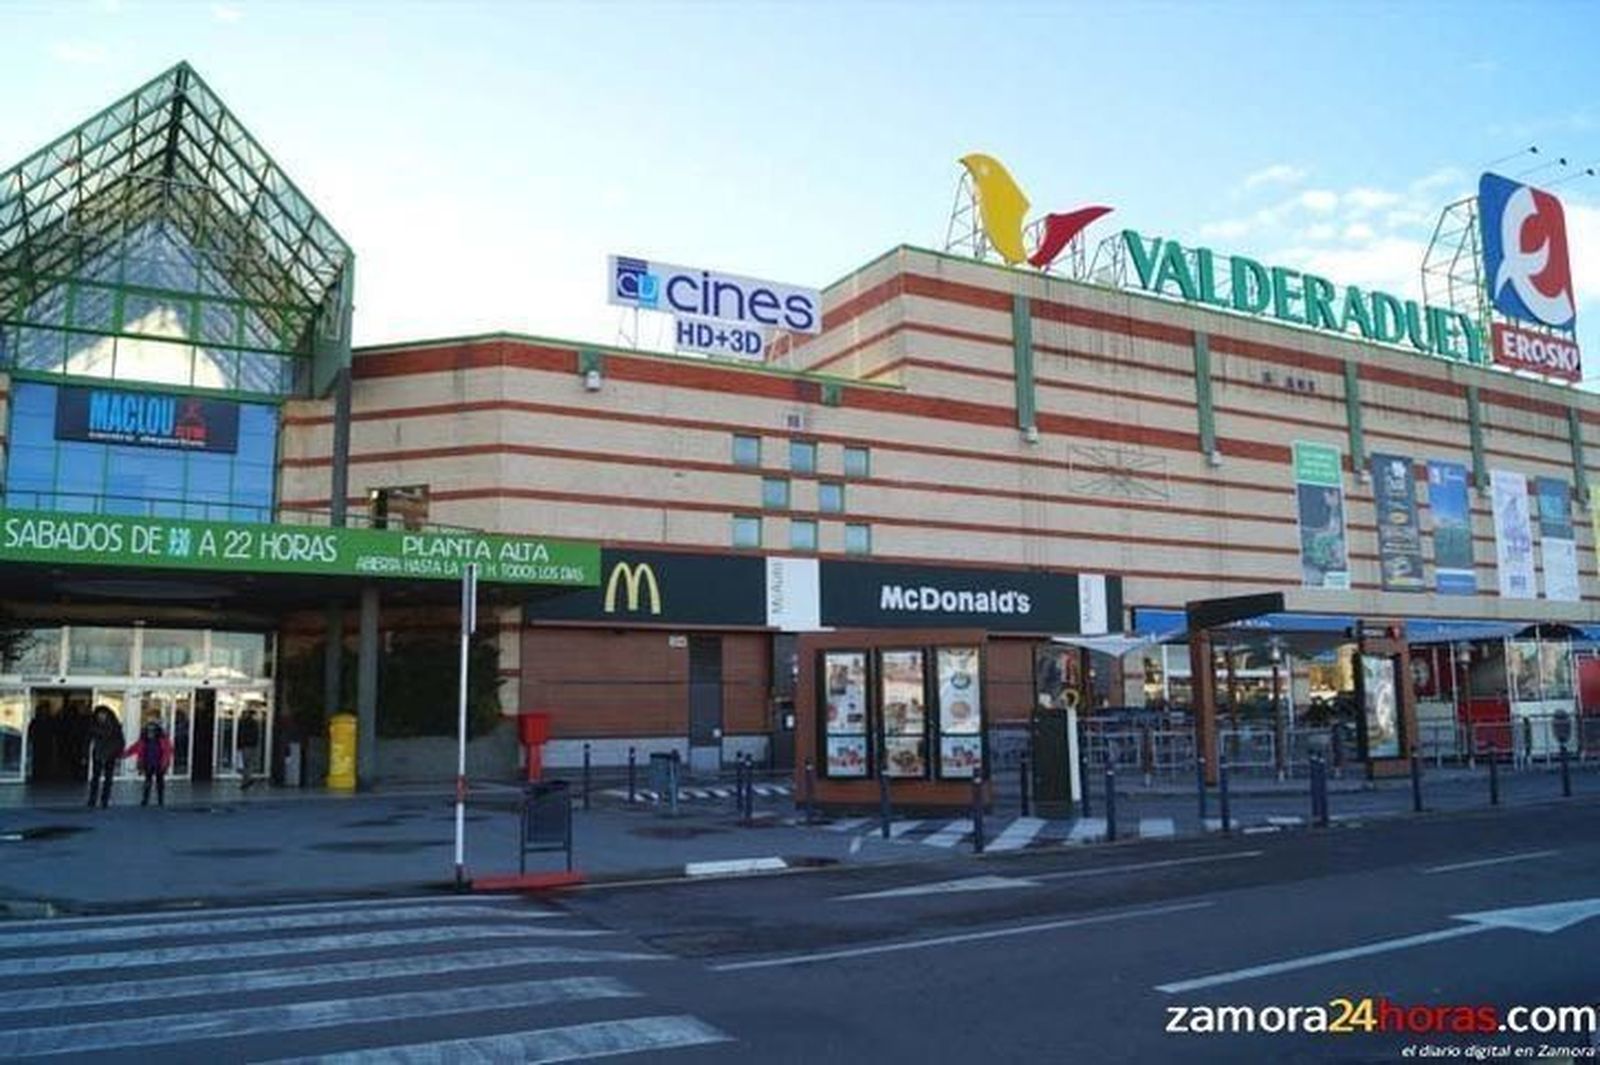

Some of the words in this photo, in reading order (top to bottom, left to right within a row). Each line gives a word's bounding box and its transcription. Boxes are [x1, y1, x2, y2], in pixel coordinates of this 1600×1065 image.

[666, 270, 814, 330] cines
[1122, 229, 1484, 364] VALDERADUEY
[676, 320, 762, 354] HD+3D
[1502, 330, 1578, 371] EROSKI
[89, 390, 175, 436] MACLOU
[4, 518, 123, 552] SABADOS
[131, 525, 162, 554] DE
[199, 528, 217, 557] A
[223, 530, 252, 558] 22
[260, 531, 337, 562] HORAS
[402, 536, 491, 559] PLANTA
[499, 541, 550, 563] ALTA
[880, 585, 1032, 614] McDonald's
